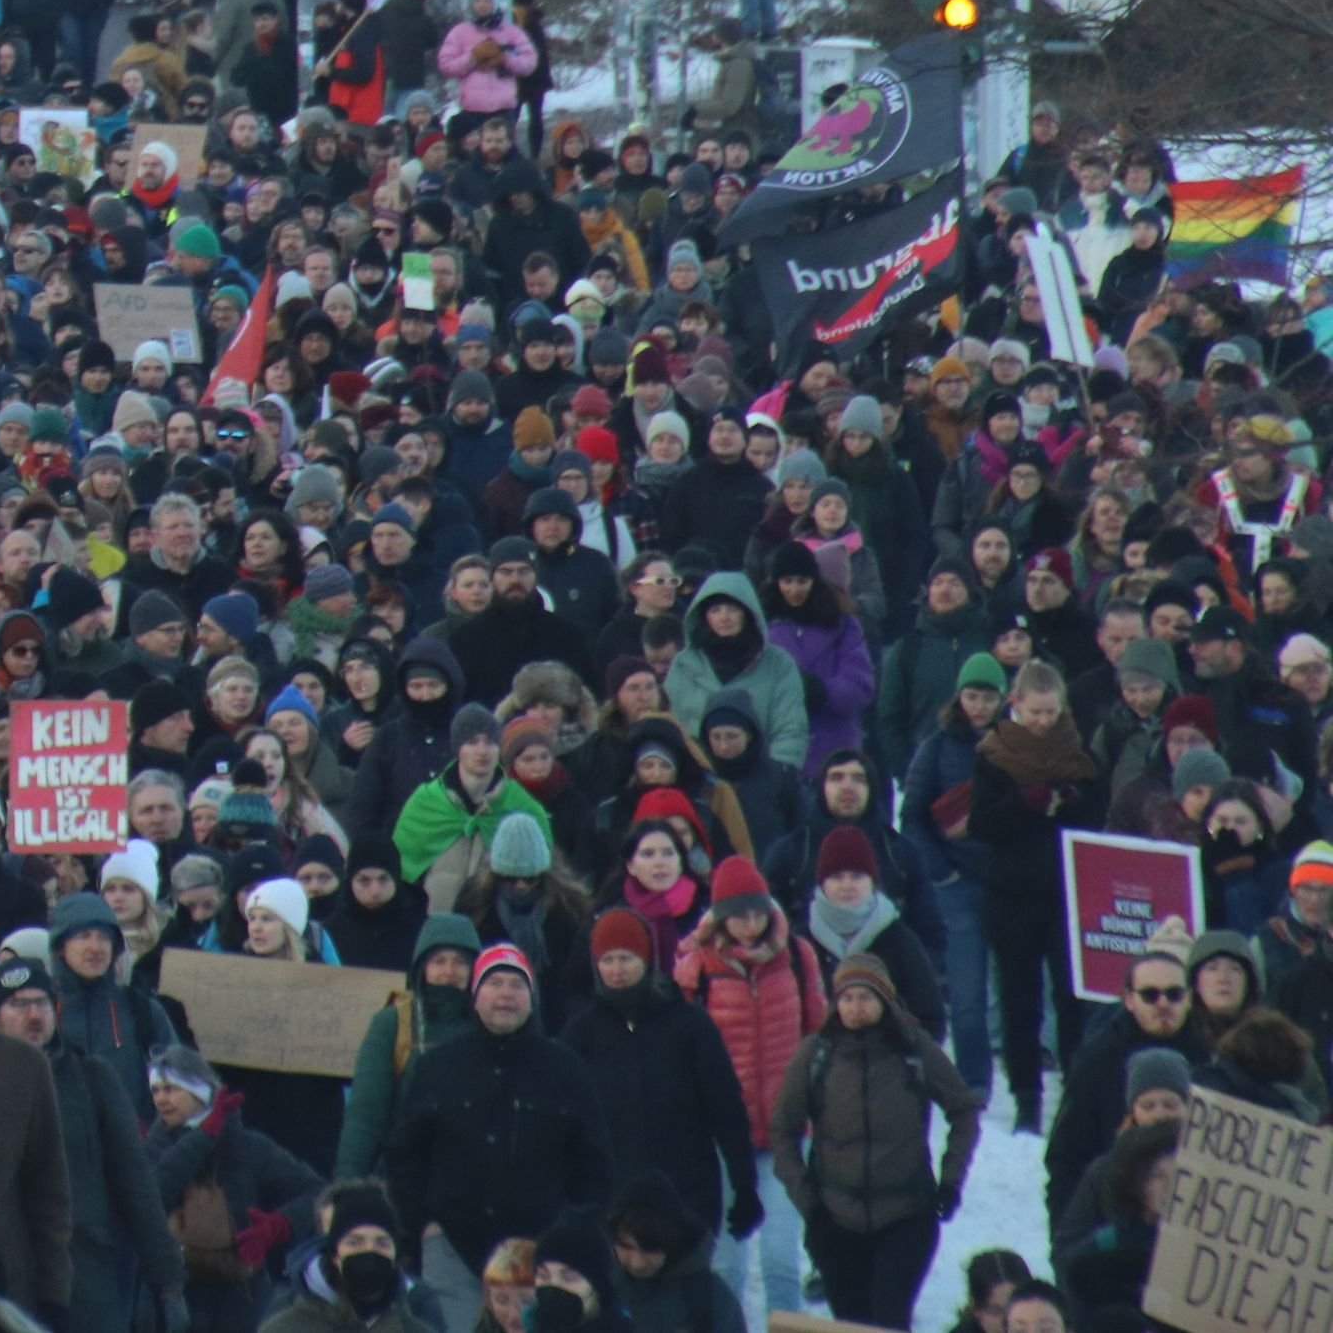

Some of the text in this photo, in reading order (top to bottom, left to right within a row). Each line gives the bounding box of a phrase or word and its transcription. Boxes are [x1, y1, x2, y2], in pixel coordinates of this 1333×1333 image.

[33, 708, 110, 752] KEIN
[18, 754, 128, 789] MENSCH
[56, 788, 92, 809] IST
[14, 808, 128, 846] ILLEGAL!
[1183, 1095, 1321, 1190] PROBLEME
[1166, 1169, 1315, 1267] FASCHOS
[1185, 1245, 1268, 1326] DIE
